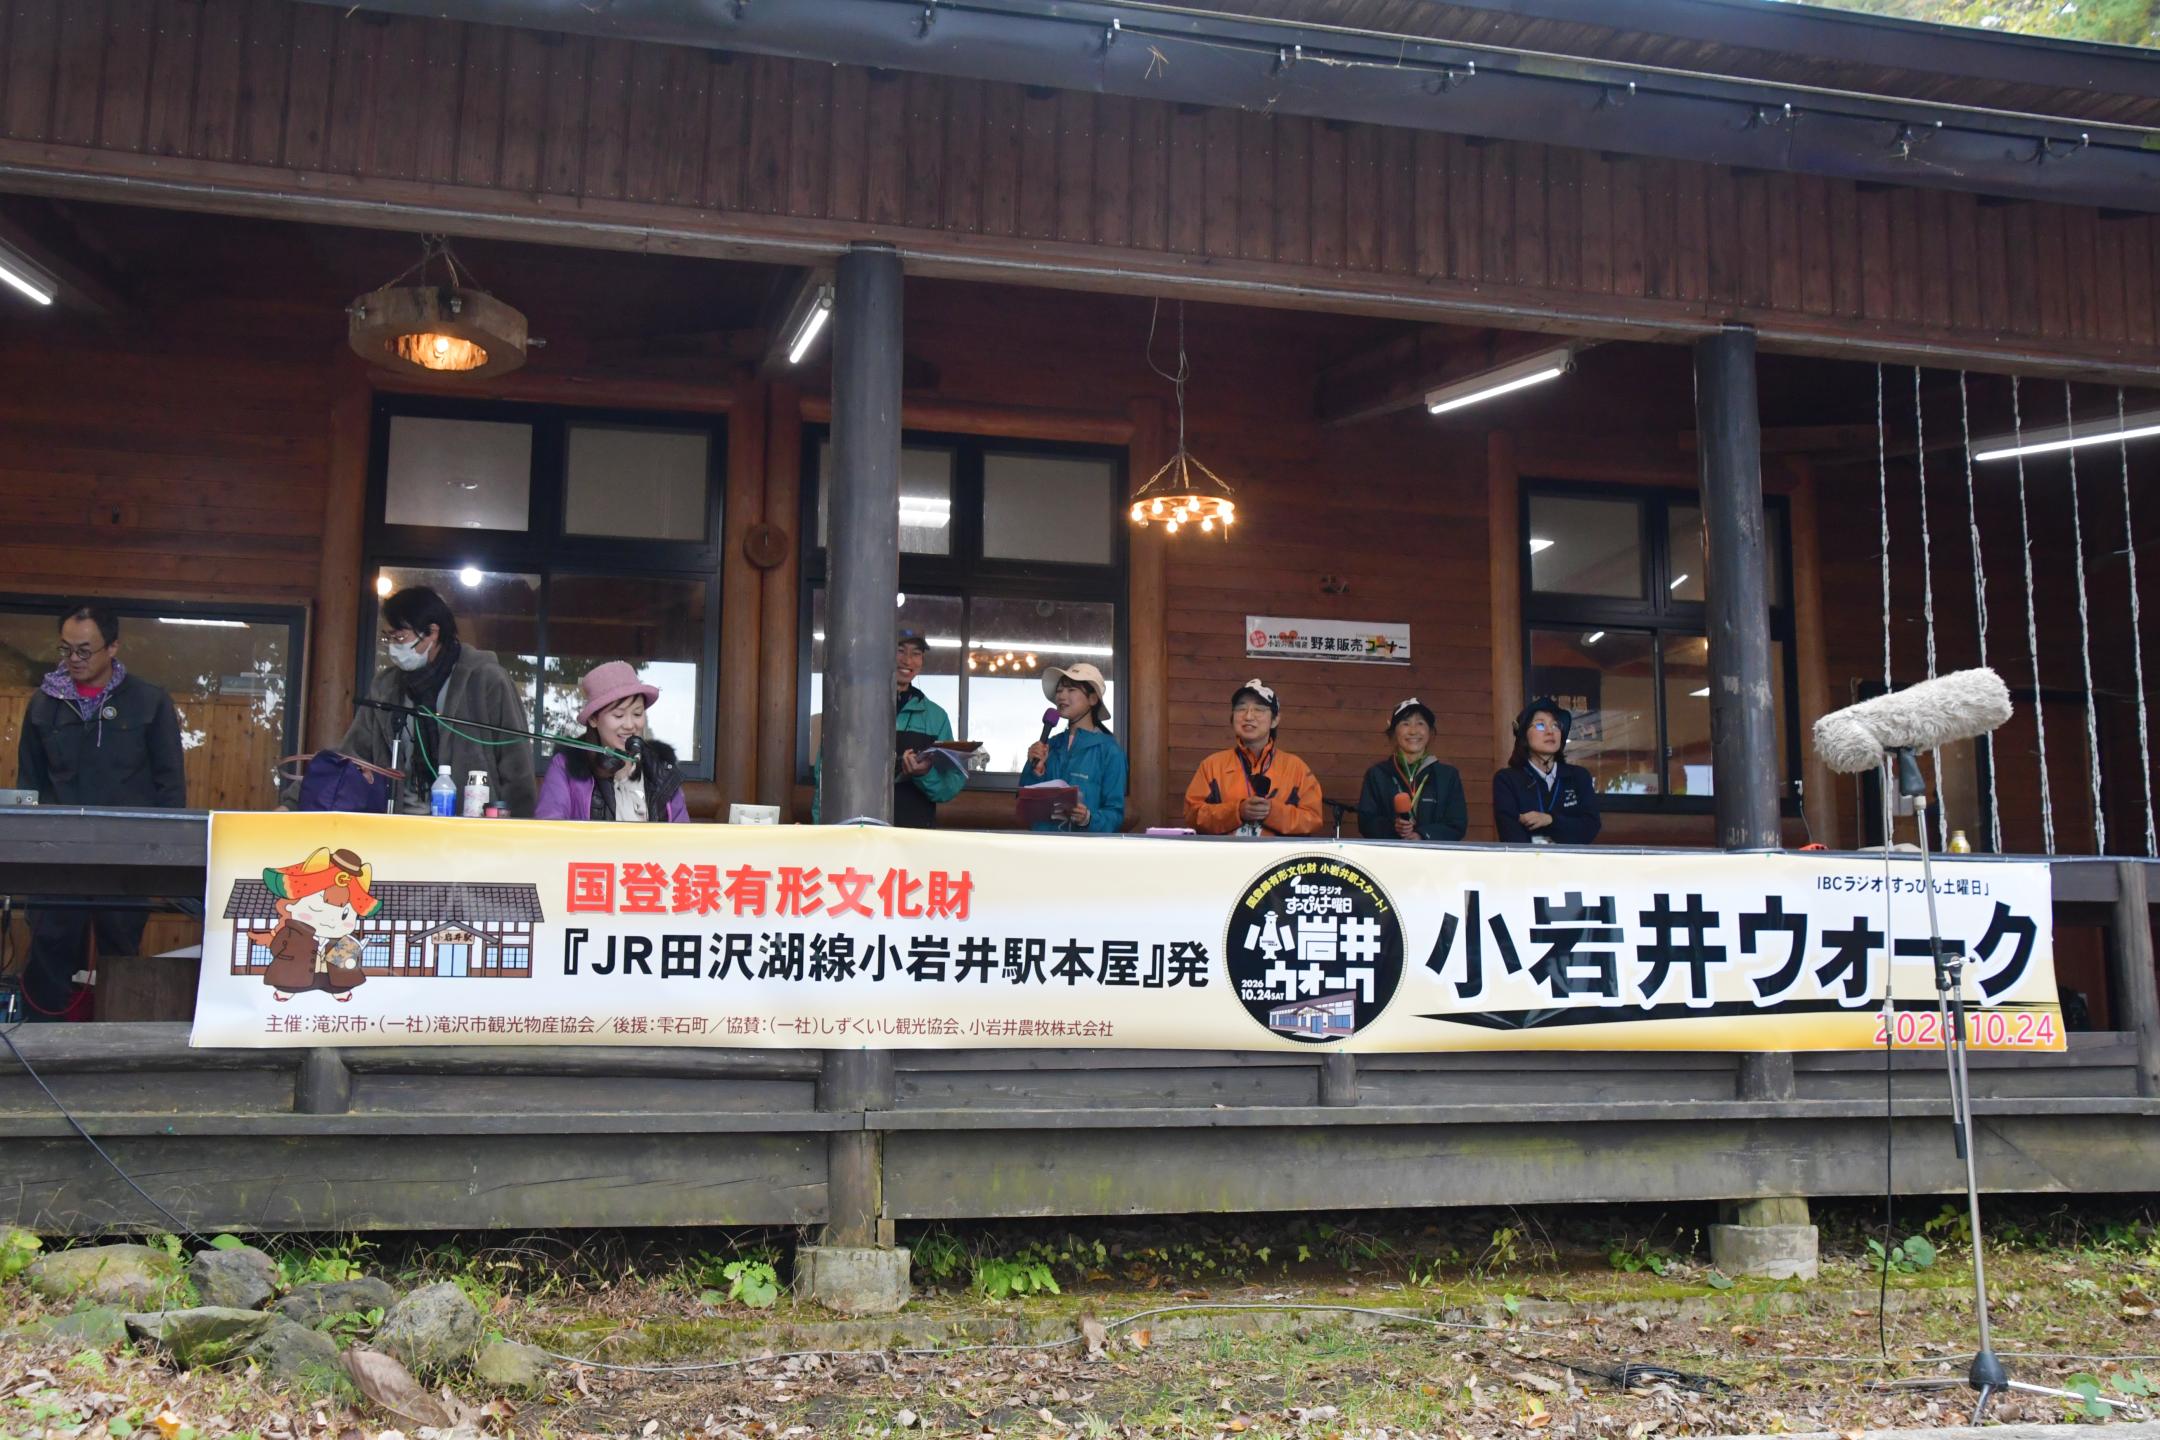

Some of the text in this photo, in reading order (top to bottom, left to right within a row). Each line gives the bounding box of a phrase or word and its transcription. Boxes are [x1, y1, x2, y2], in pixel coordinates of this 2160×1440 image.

[1311, 636, 1407, 653] 野菜販売コーナー
[566, 862, 973, 918] 国登録有形文化財
[563, 928, 1209, 988] 『JR田沢湖線小岩井駅本屋』発
[1426, 890, 2037, 998] 小岩井ウォーク
[1241, 980, 1264, 988] 2026
